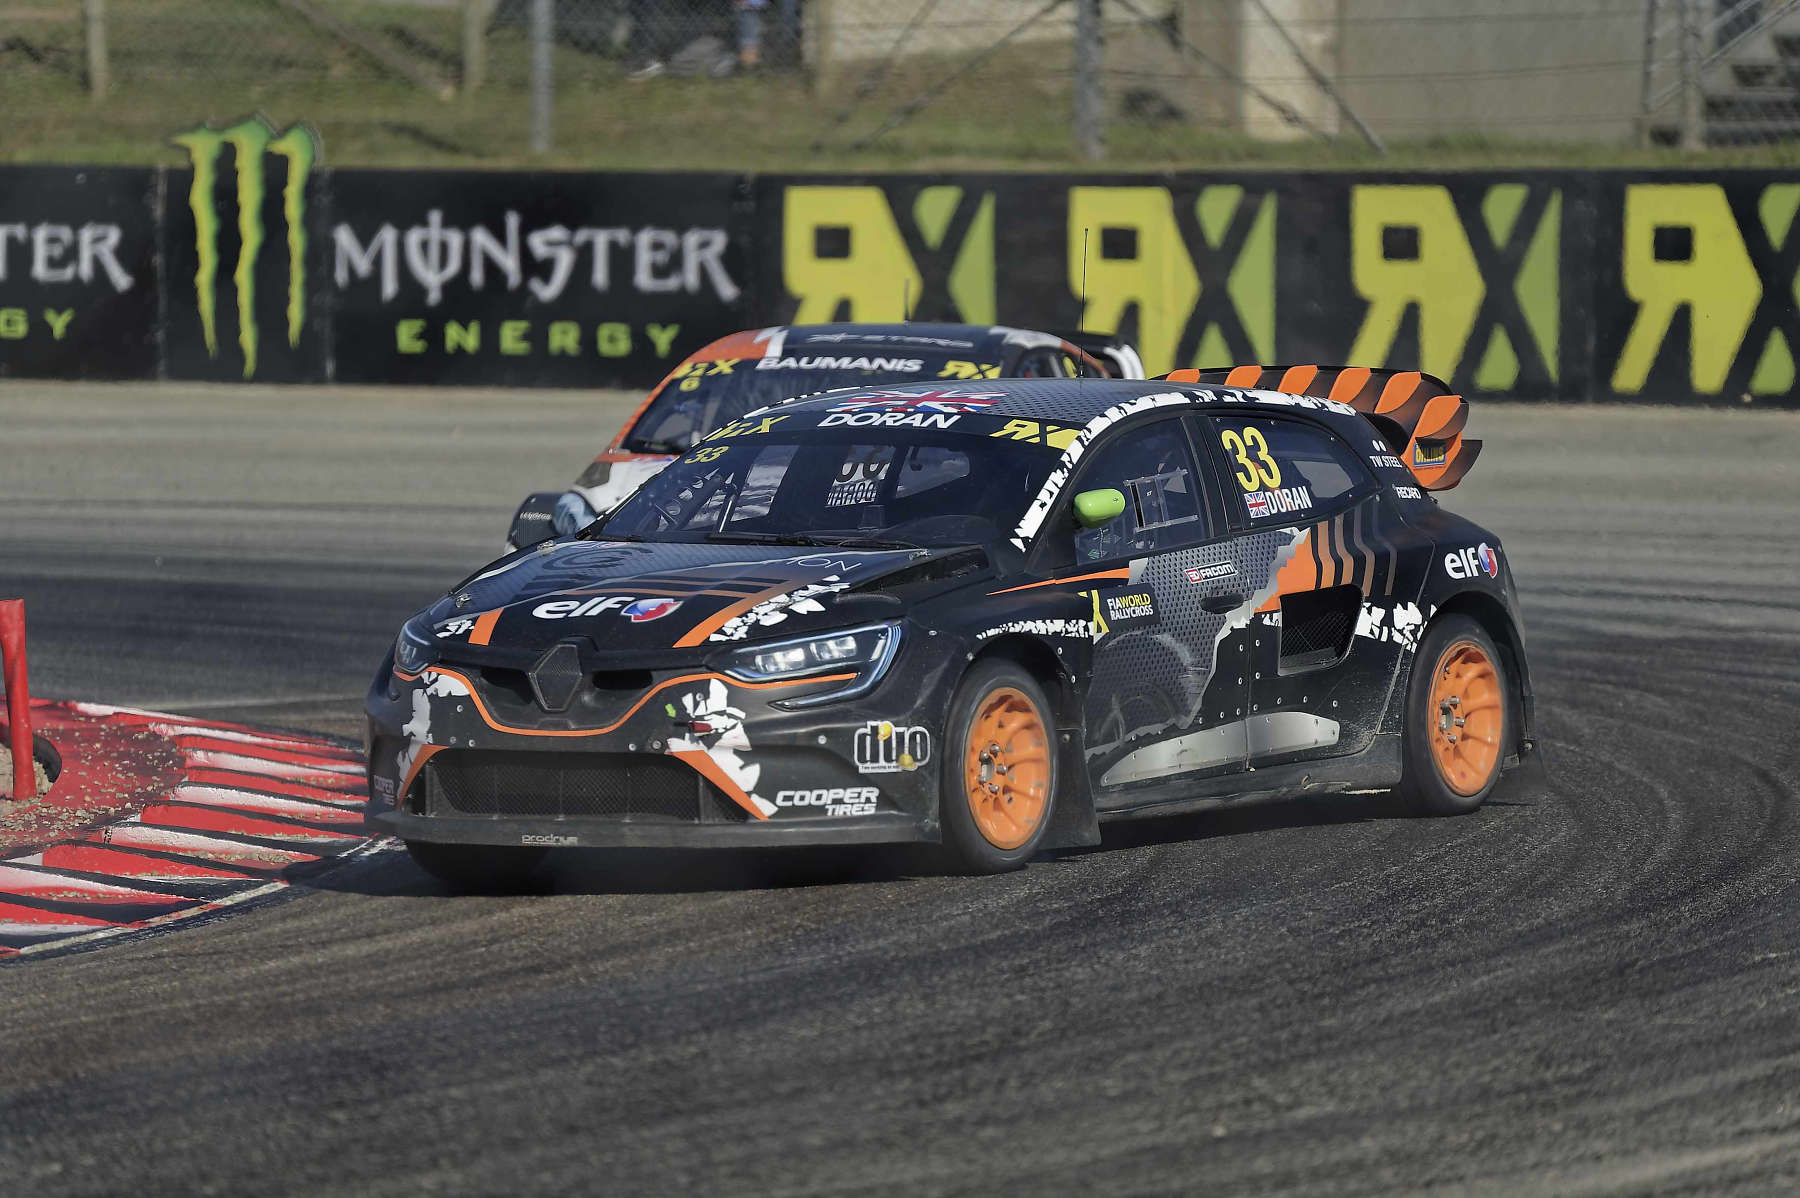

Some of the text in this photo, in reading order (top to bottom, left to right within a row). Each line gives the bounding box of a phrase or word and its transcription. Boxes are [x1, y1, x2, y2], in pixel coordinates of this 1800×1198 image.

[333, 209, 740, 306] MONSTER
[395, 318, 681, 358] ENERGY
[755, 356, 924, 373] BAUMANIS
[817, 412, 961, 429] DORAN
[684, 445, 729, 464] 33
[1221, 426, 1281, 492] 33
[1265, 486, 1312, 515] DORAN
[1444, 547, 1479, 579] elf
[532, 597, 636, 619] elf
[1110, 604, 1154, 621] RALLYCROSS
[776, 786, 880, 807] COOPER
[825, 803, 877, 817] TIRES
